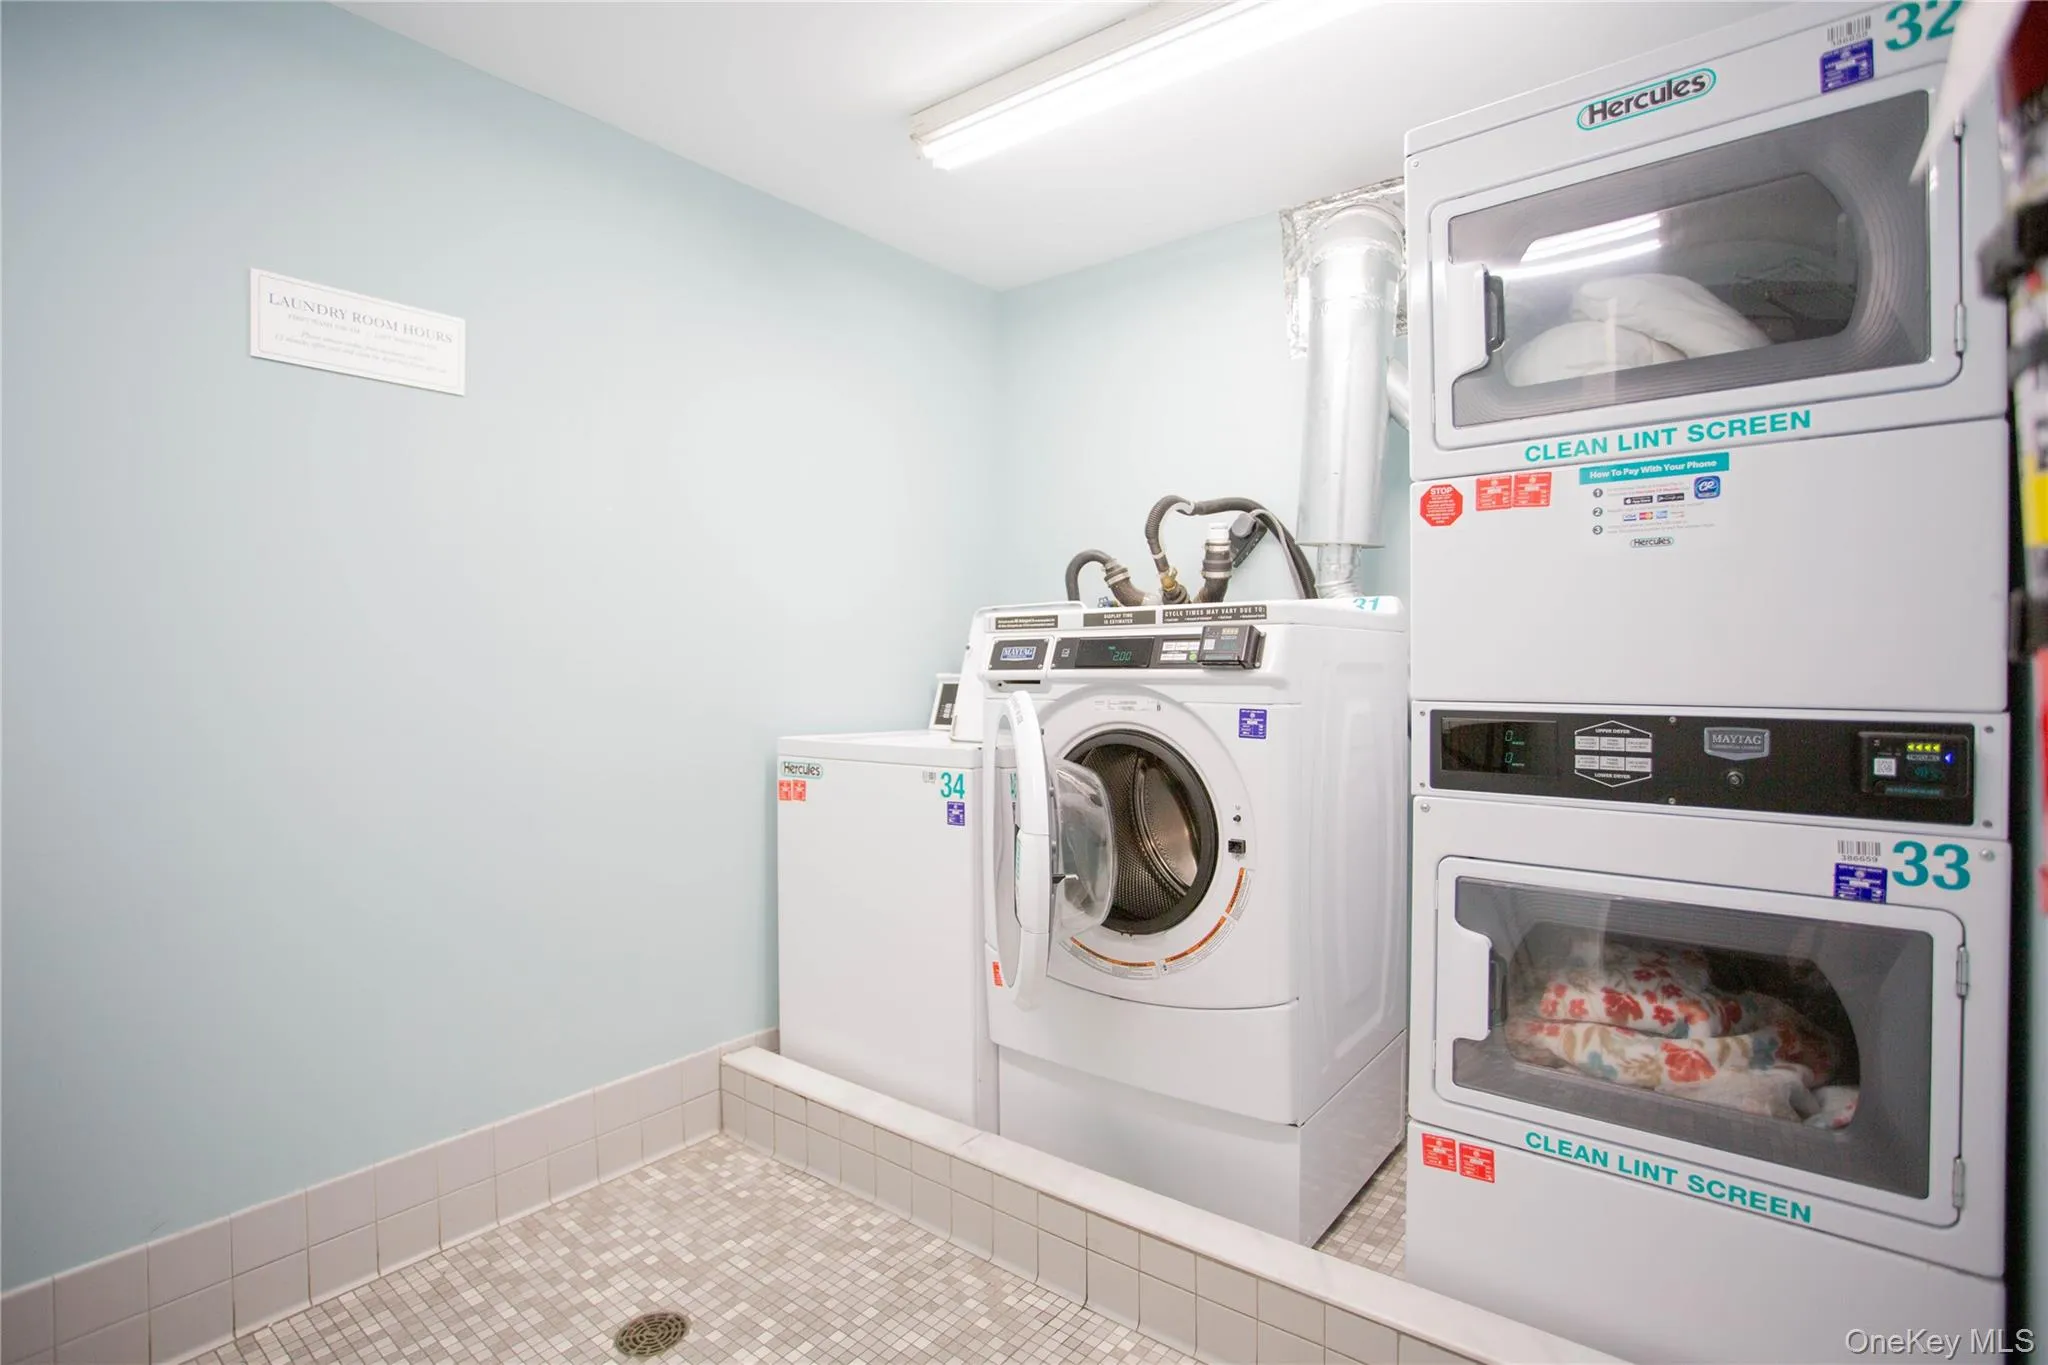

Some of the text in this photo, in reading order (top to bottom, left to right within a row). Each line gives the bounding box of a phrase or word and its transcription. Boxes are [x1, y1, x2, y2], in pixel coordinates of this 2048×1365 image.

[1885, 0, 1962, 51] 32
[1588, 75, 1706, 124] Hercules
[269, 293, 347, 320] LAUNDRY
[352, 312, 398, 332] ROOM
[403, 323, 453, 344] HOURS
[1525, 410, 1811, 462] CLEAN LINT SCREEN
[1589, 471, 1610, 479] How
[1623, 468, 1640, 477] Pay
[1640, 465, 1662, 474] With
[1663, 463, 1685, 472] Your
[1686, 460, 1718, 470] Phone
[1430, 487, 1453, 495] STOP
[1634, 537, 1671, 546] Hercules
[1003, 647, 1035, 656] MAYTAG
[1505, 730, 1513, 742] 0
[1712, 734, 1761, 745] MAYTAG
[1505, 752, 1513, 763] 0
[783, 762, 821, 776] Hercules
[940, 771, 965, 799] 34
[1892, 840, 1971, 890] 33
[1525, 1131, 1608, 1168] CLEAN
[1618, 1155, 1678, 1185] LINT
[1688, 1174, 1811, 1223] SCREEN
